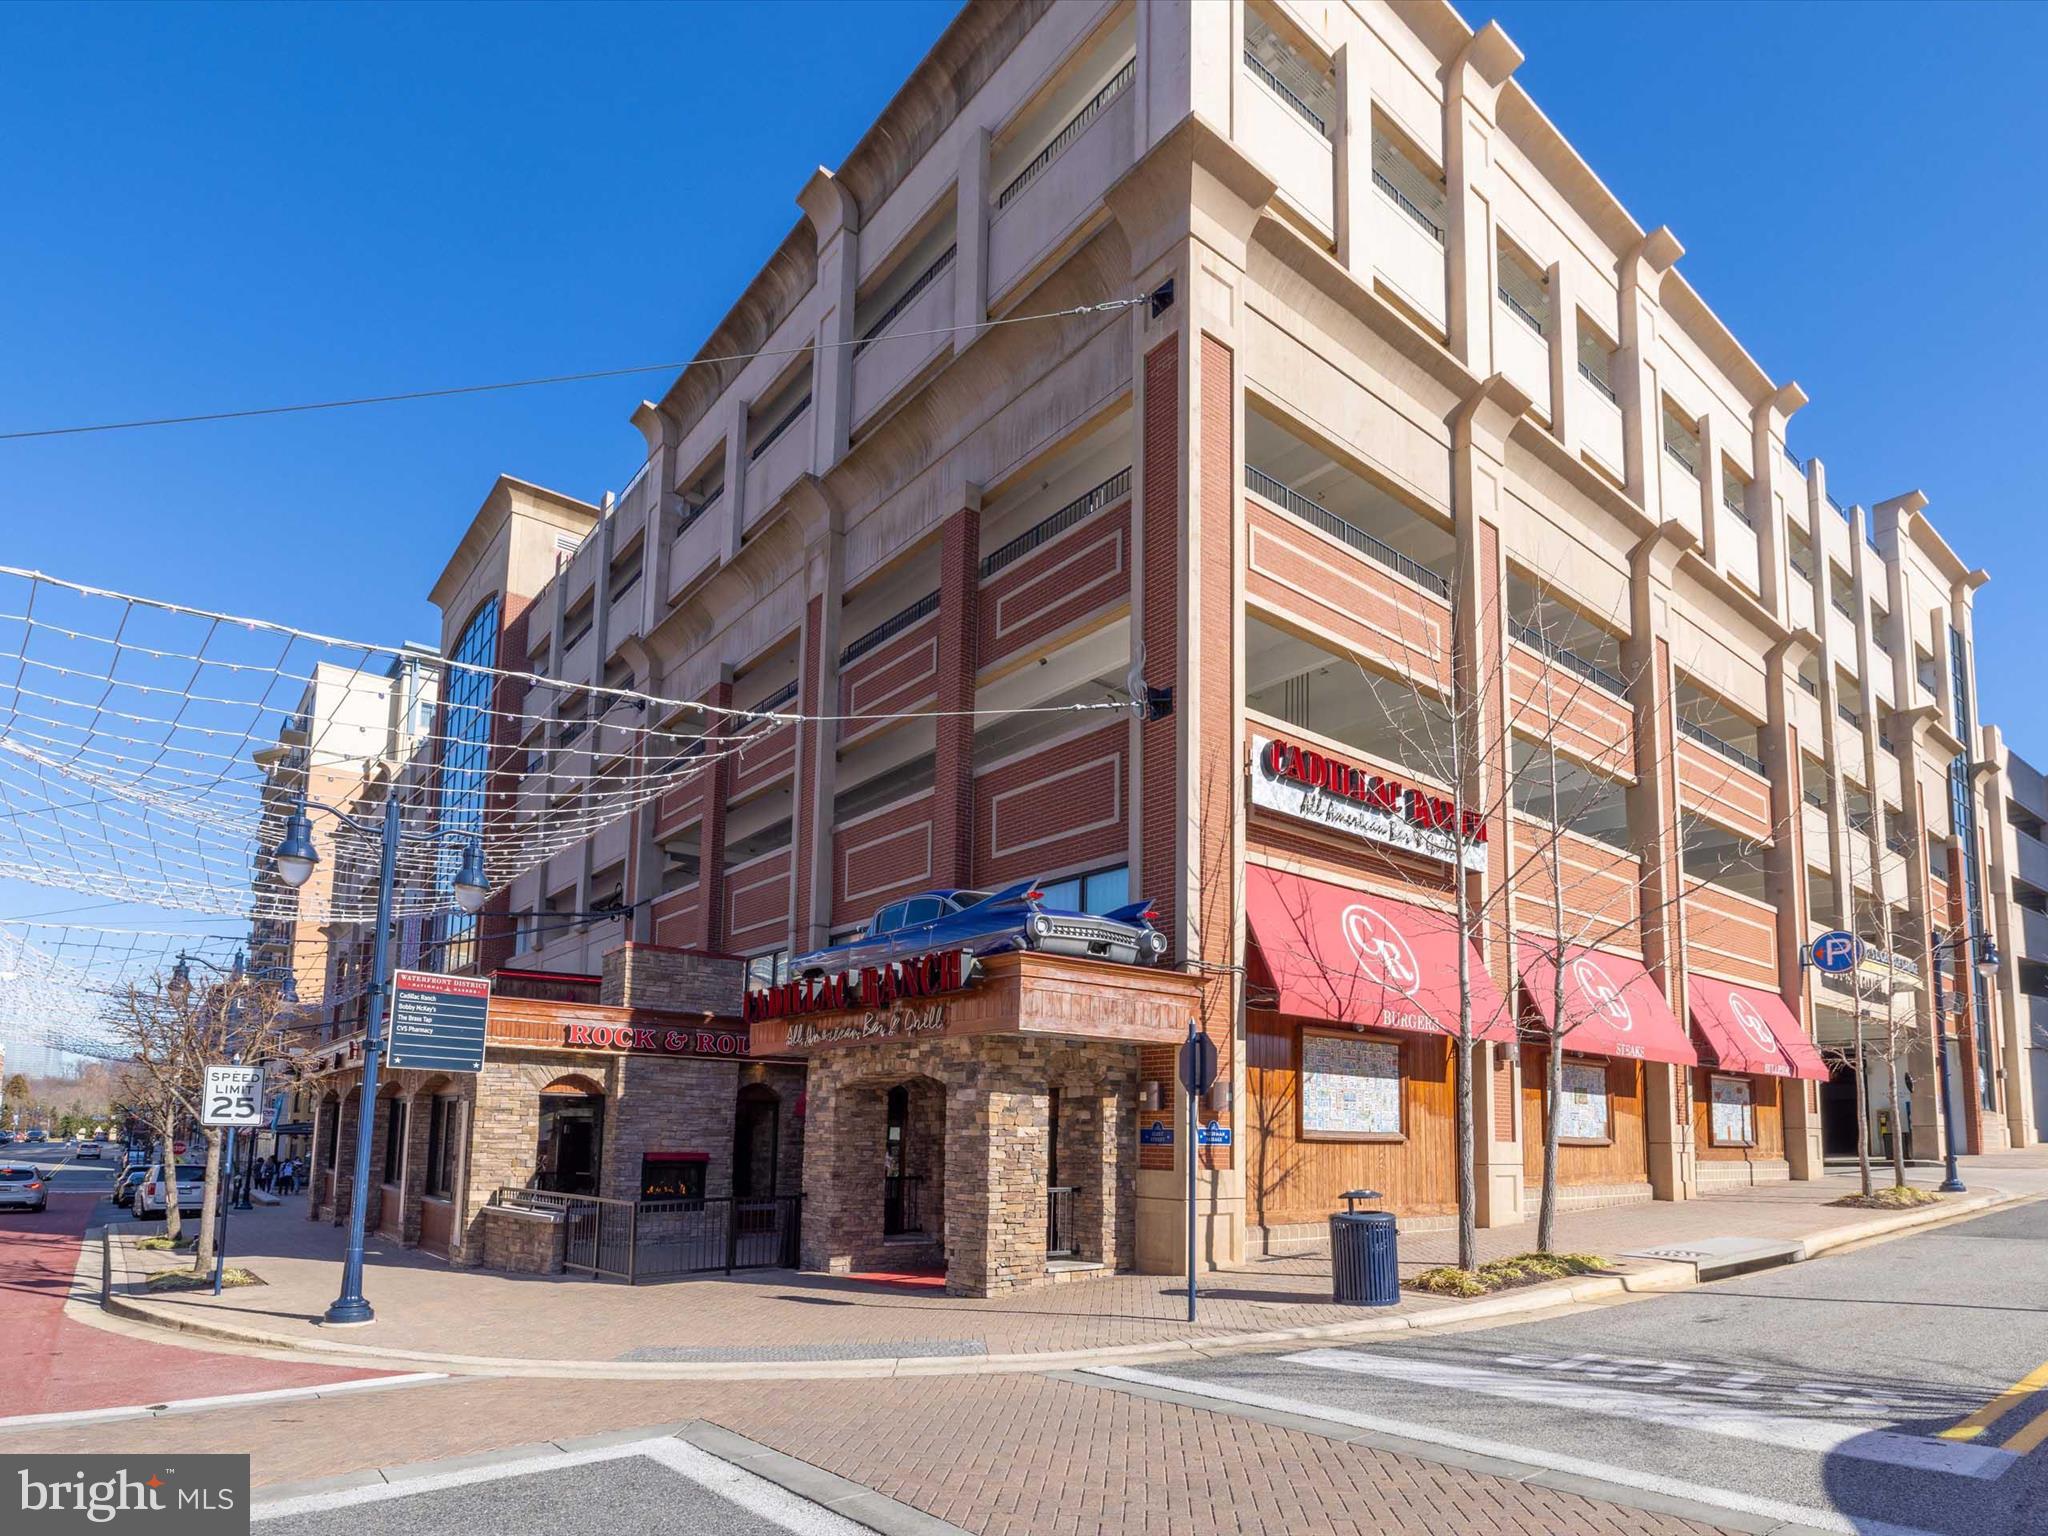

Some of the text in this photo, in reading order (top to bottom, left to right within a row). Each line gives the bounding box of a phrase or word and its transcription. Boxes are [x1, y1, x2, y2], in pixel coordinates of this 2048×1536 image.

[1261, 739, 1402, 814] CADILLAC
[401, 974, 488, 990] WATERFRONT DISTRICT
[861, 949, 963, 1009] RANCH
[399, 992, 420, 1001] Cadillac
[398, 1003, 415, 1012] Bobby
[786, 1023, 803, 1047] All
[863, 1012, 885, 1037] Bar
[904, 1006, 944, 1037] Grill
[1382, 1009, 1440, 1031] BURGERS
[408, 1026, 433, 1034] Pharmacy
[568, 1023, 656, 1049] ROCK
[664, 1031, 688, 1050] &
[1616, 1042, 1645, 1058] STEAKS
[211, 1072, 260, 1083] SPEED
[215, 1085, 254, 1095] LIMIT
[210, 1096, 255, 1118] 25
